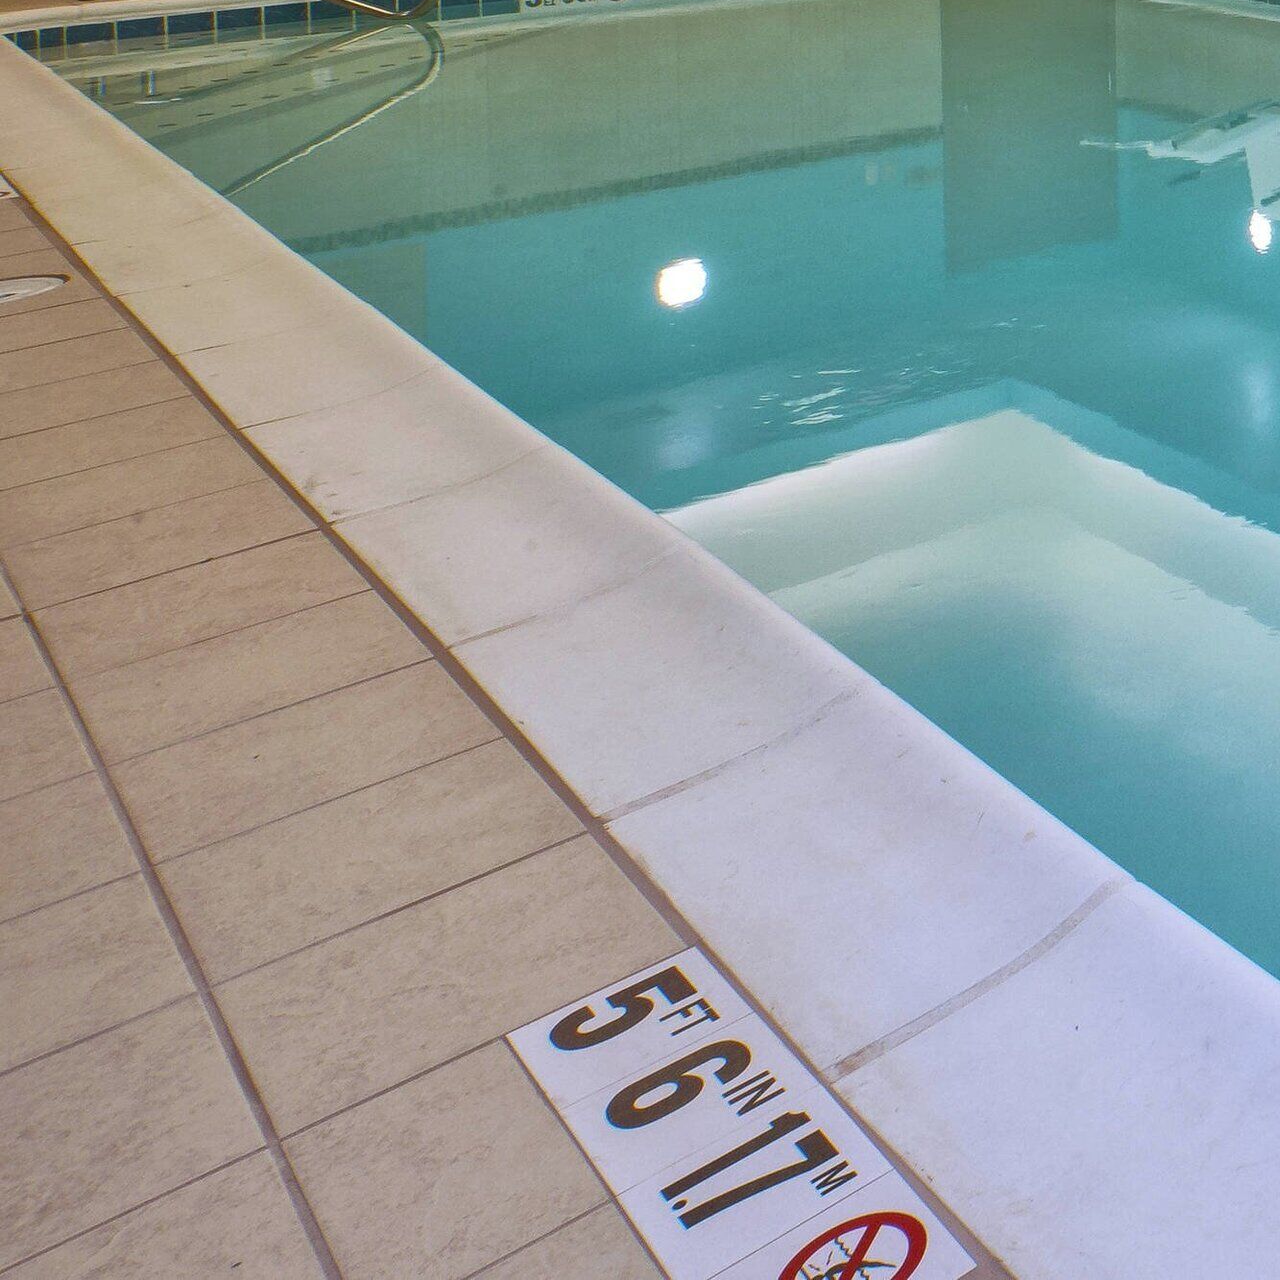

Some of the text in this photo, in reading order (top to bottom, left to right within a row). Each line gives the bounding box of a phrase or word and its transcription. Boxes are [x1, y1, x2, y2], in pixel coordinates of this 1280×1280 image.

[549, 965, 698, 1050] 5
[660, 997, 721, 1037] FT
[605, 1039, 751, 1130] 6
[722, 1070, 786, 1117] IN
[812, 1160, 859, 1197] M
